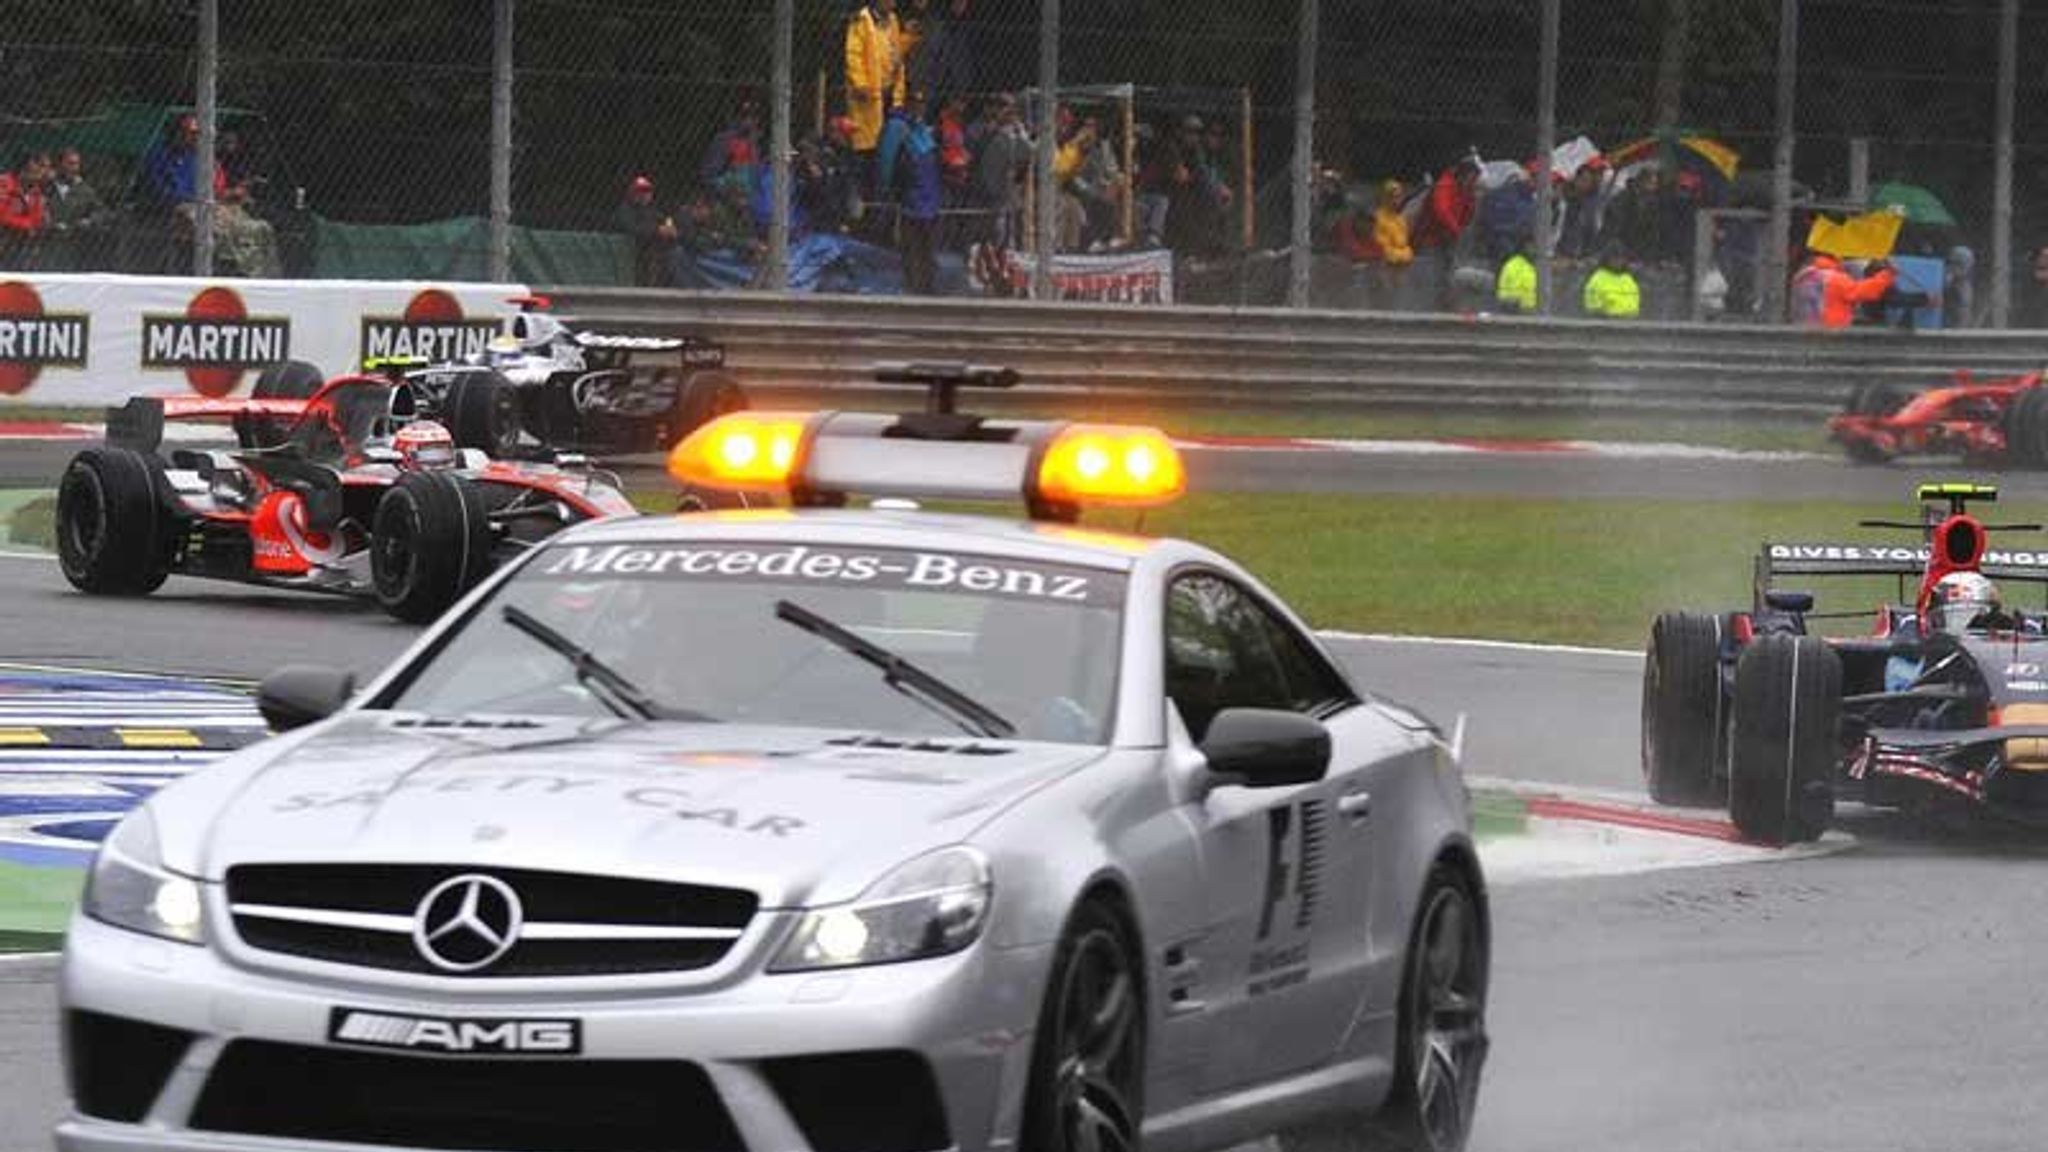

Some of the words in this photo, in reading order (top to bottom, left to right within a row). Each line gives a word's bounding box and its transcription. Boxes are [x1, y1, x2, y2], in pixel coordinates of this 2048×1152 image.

[150, 324, 282, 361] MARTINI
[1770, 545, 1860, 559] GIVES
[546, 544, 1088, 601] Mercedes-Benz
[623, 786, 806, 837] CAR
[405, 1019, 575, 1050] AMG
